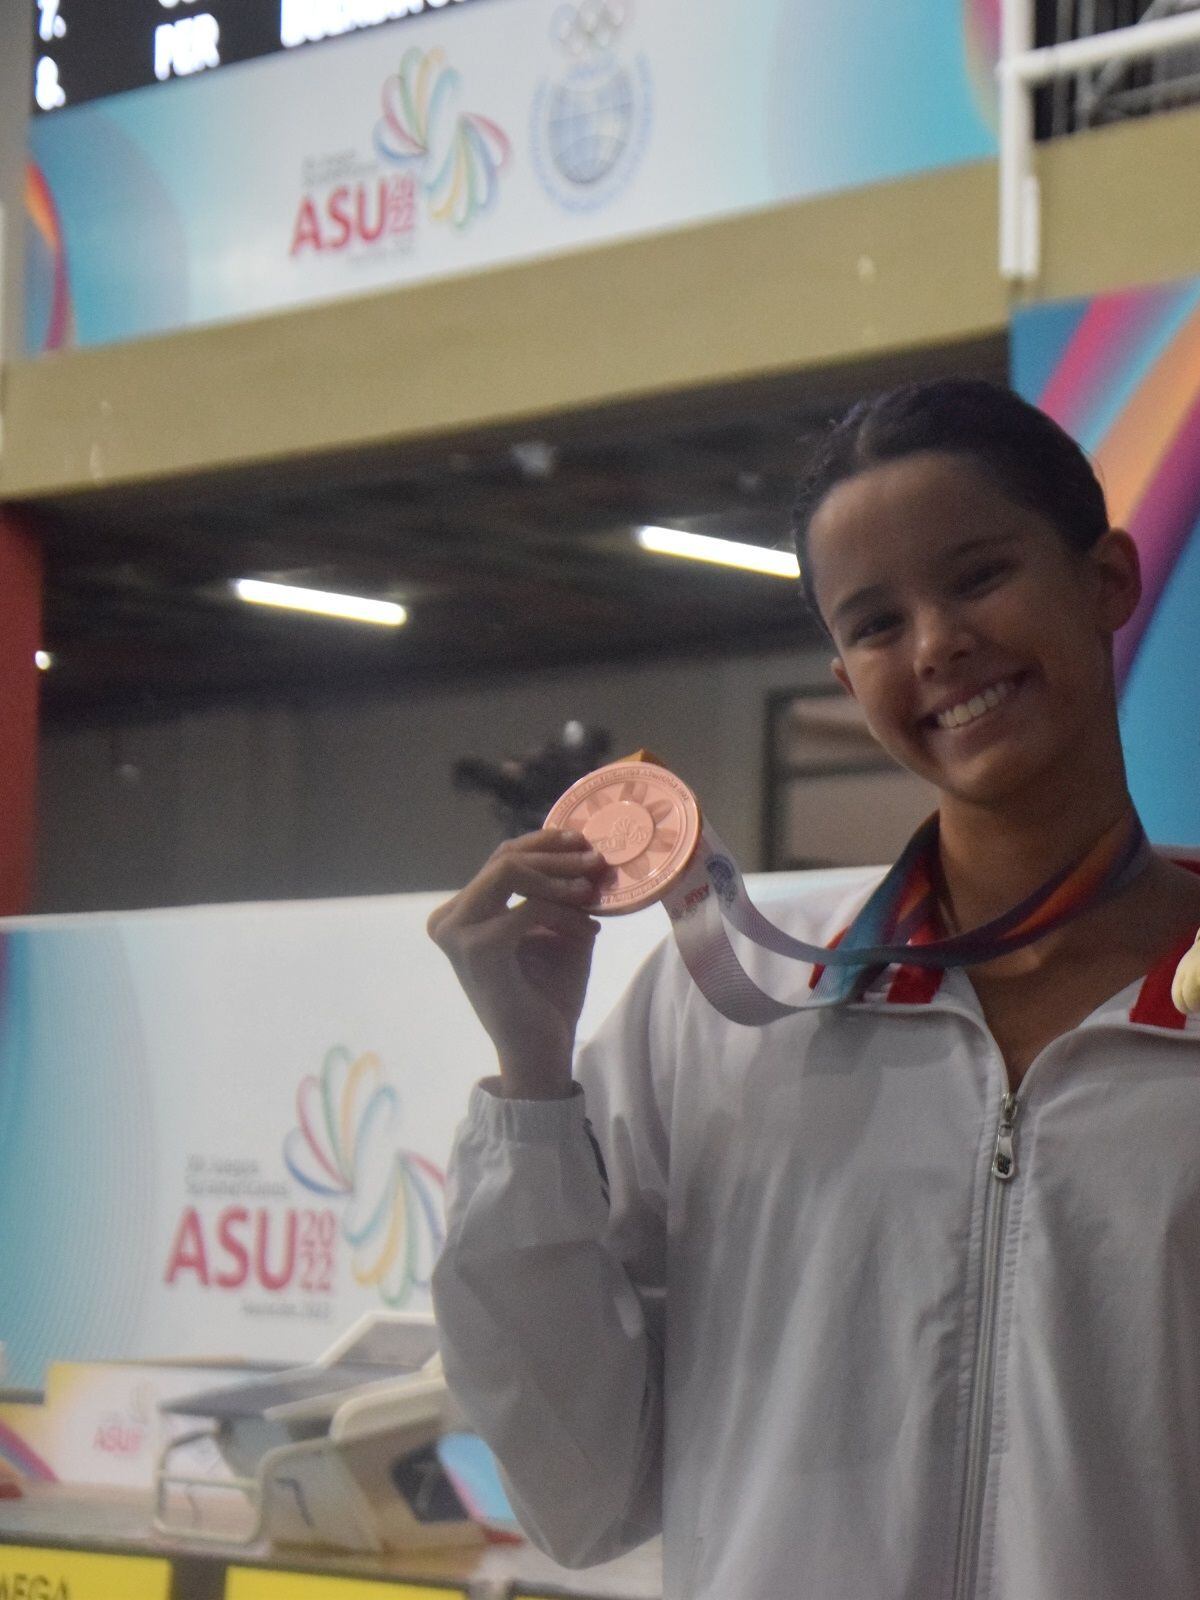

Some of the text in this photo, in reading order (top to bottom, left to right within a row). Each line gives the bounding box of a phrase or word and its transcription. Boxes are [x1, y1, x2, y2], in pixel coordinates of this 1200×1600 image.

[289, 174, 388, 259] ASU
[164, 1205, 298, 1291] ASU
[299, 1250, 335, 1292] 22
